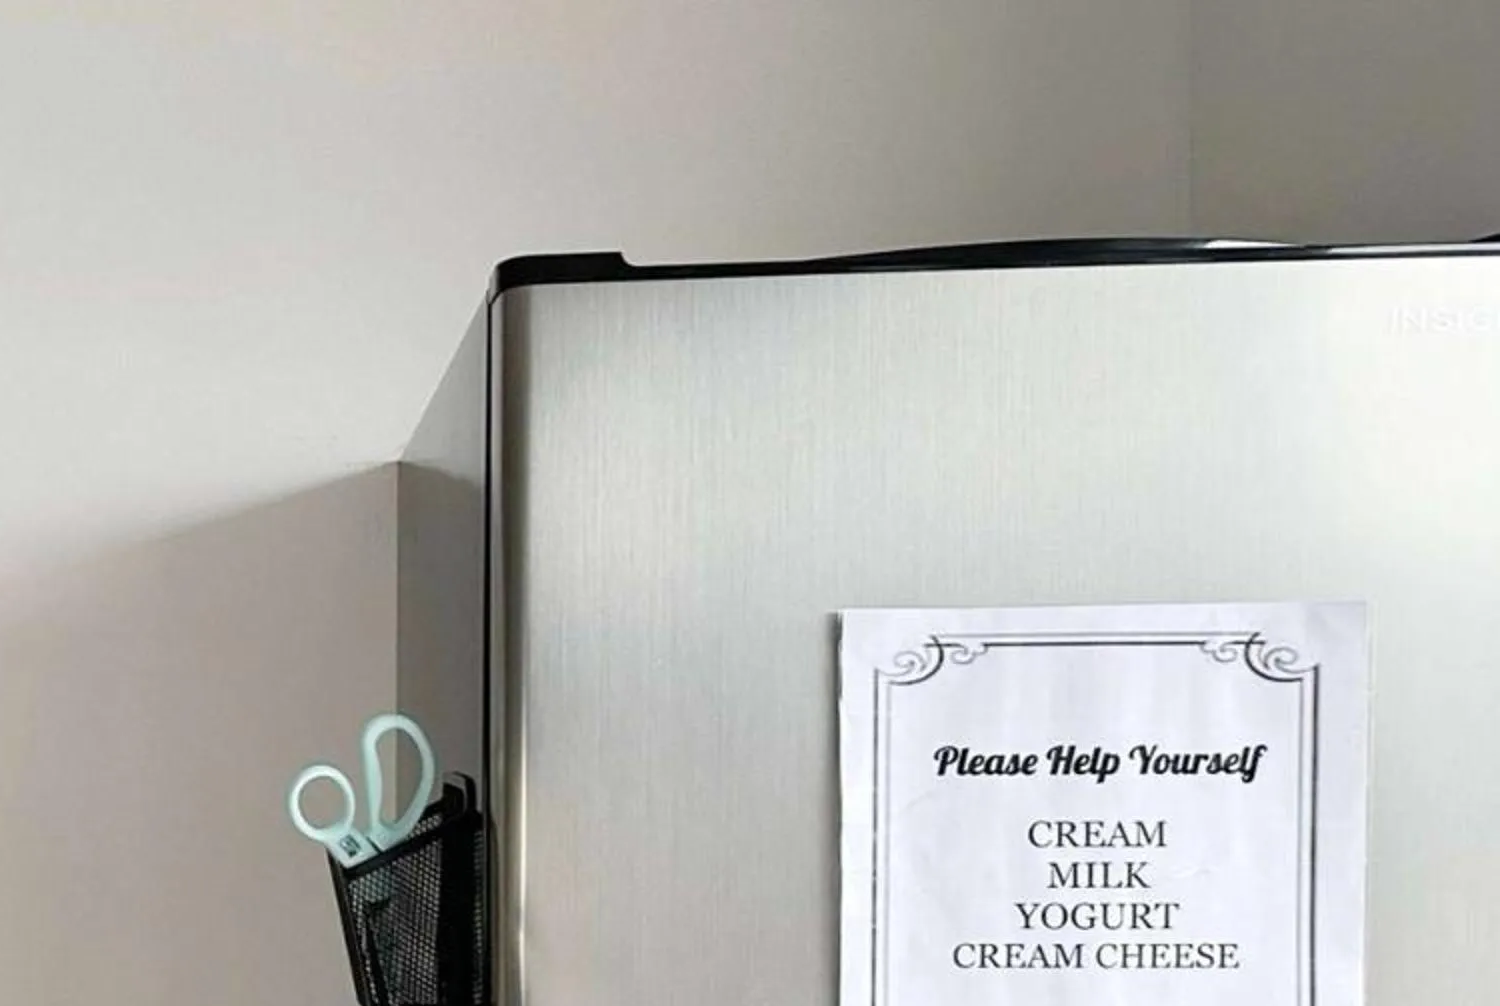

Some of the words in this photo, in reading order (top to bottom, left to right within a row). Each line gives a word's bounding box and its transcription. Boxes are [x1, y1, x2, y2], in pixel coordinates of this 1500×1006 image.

[1391, 306, 1500, 331] INSIG
[933, 745, 1038, 777] Please
[1046, 745, 1120, 784] Help
[1129, 744, 1268, 784] Yourself
[1027, 820, 1168, 848] CREAM
[1047, 861, 1151, 889] MILK
[1014, 902, 1180, 930] YOGURT
[952, 943, 1084, 969] CREAM
[1095, 943, 1240, 969] CHEESE
